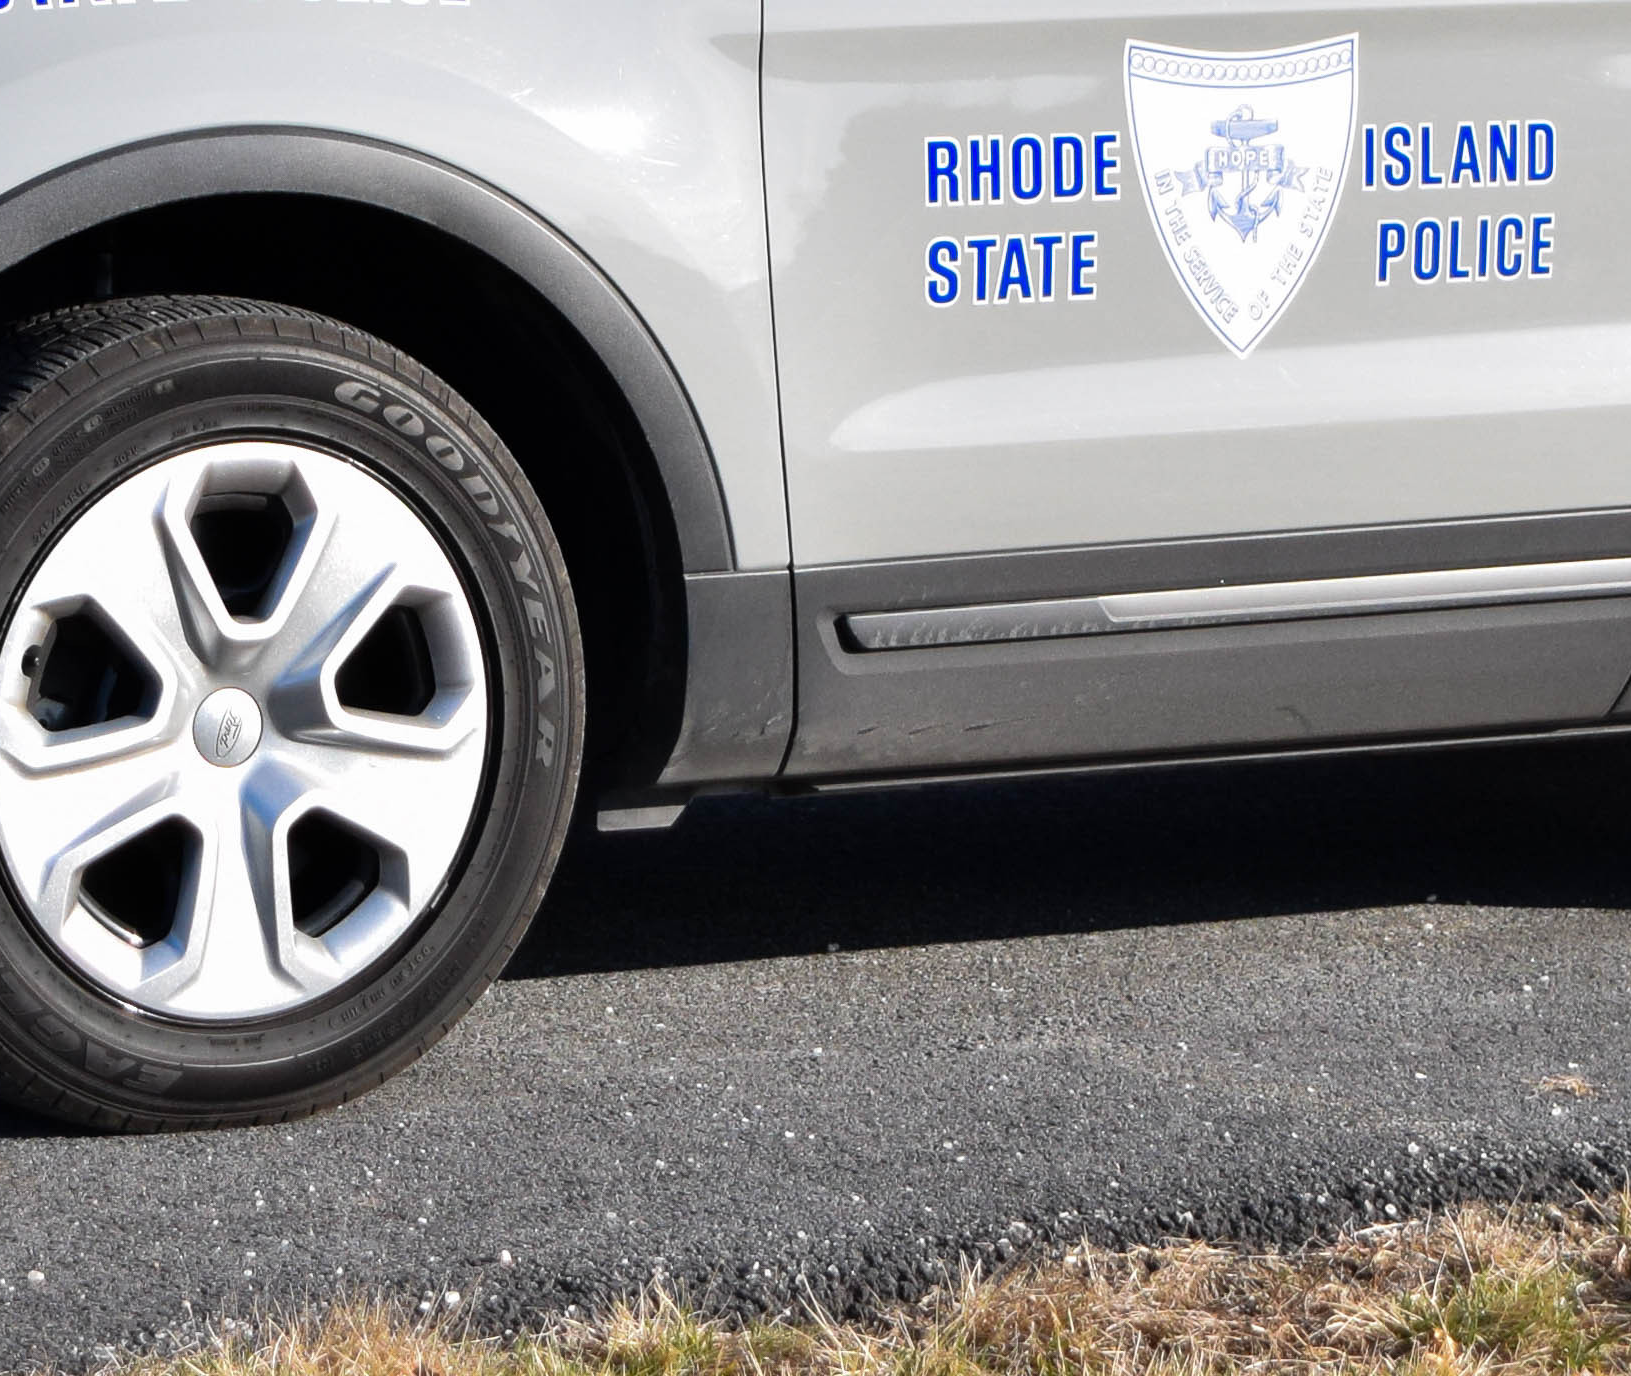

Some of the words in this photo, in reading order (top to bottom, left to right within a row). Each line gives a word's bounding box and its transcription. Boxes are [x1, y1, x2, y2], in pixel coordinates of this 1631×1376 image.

[924, 131, 1121, 207] RHODE
[1360, 119, 1557, 192] ISLAND
[1218, 148, 1270, 168] HOPE
[924, 231, 1098, 309] STATE
[1375, 213, 1557, 287] POLICE
[1154, 168, 1175, 197] IN
[1165, 199, 1193, 246] THE
[1183, 245, 1240, 325] SERVICE
[1248, 290, 1271, 321] OF
[1271, 243, 1304, 287] THE
[1299, 166, 1333, 238] STATE
[334, 381, 557, 768] GOODYEAR
